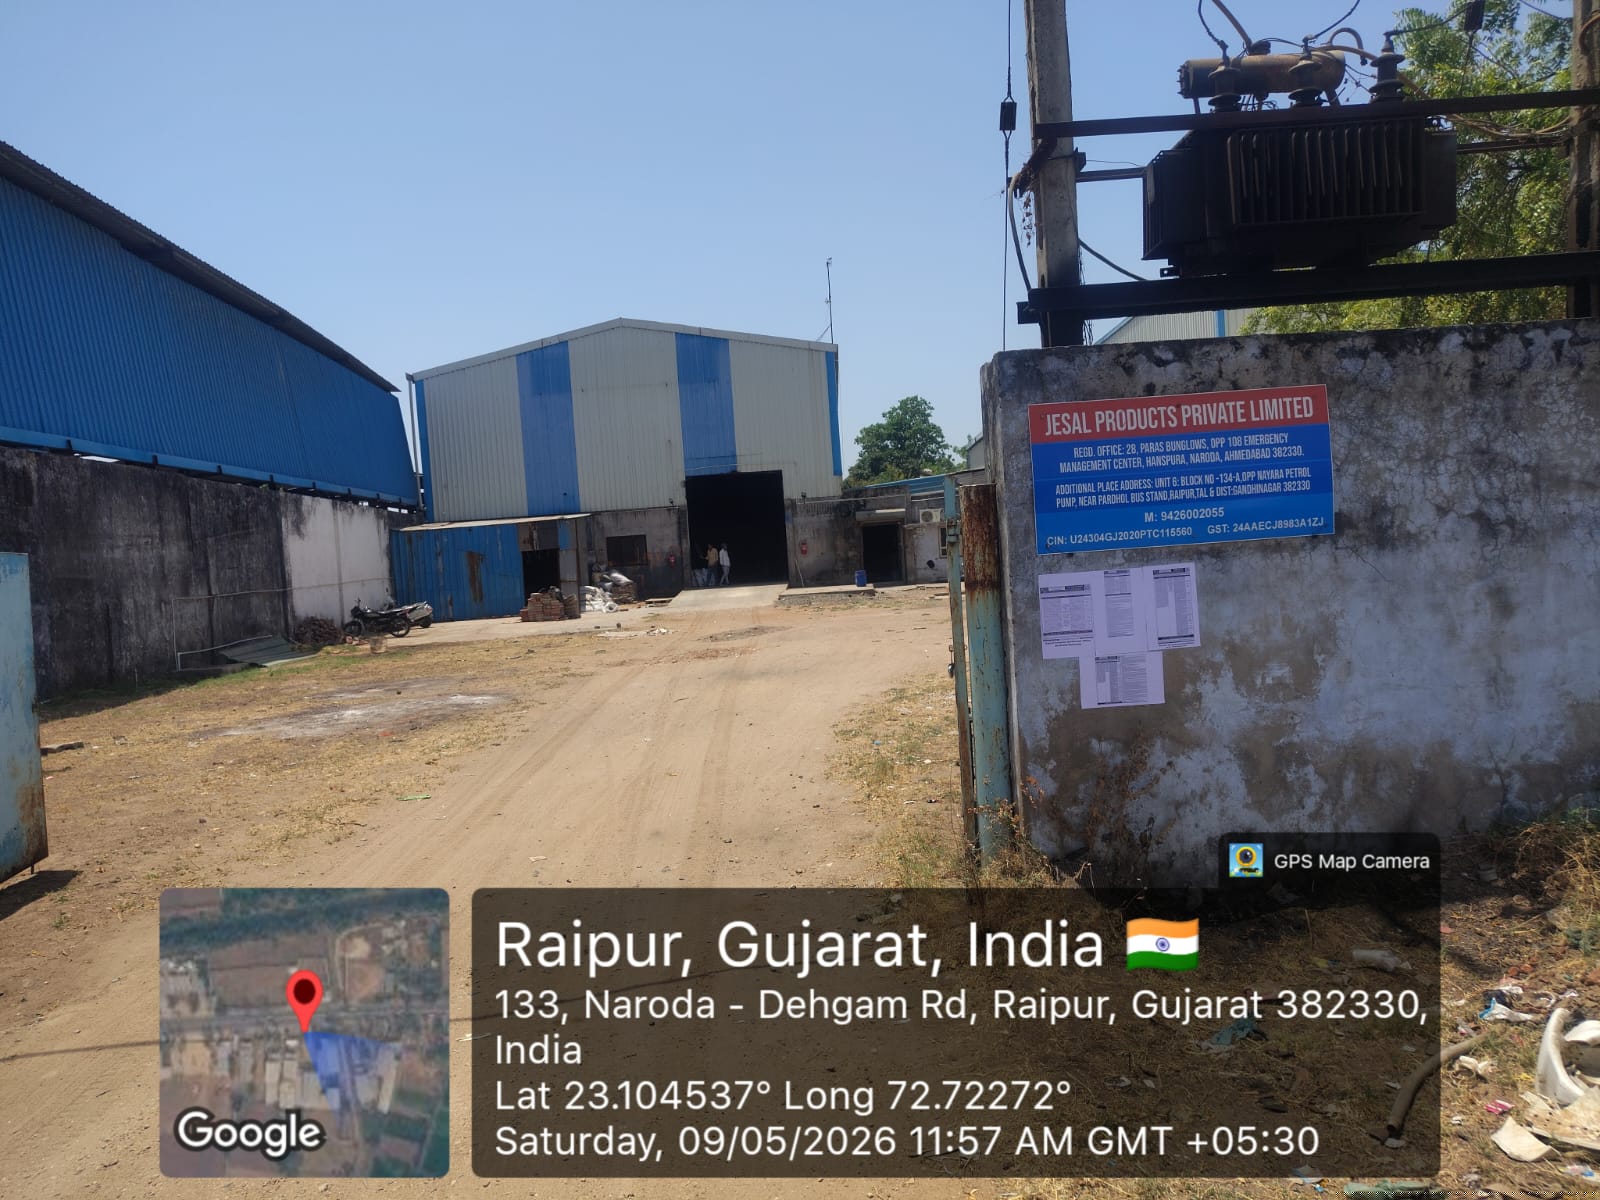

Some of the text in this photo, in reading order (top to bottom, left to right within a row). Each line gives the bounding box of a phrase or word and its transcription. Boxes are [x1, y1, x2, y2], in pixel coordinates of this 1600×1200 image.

[1045, 396, 1313, 436] JESAL PRODUCTS PRIVATE LIMITED
[1073, 446, 1095, 458] REGD.
[1097, 444, 1125, 457] OFFICE:
[1140, 441, 1164, 454] PARAS
[1165, 438, 1209, 452] BUNGLOWS,
[1210, 437, 1226, 449] OPP
[1228, 435, 1242, 448] 108
[1244, 432, 1288, 446] EMERGENCY
[1060, 459, 1112, 473] MANAGEMENT
[1113, 456, 1145, 470] CENTER,
[1146, 453, 1189, 467] HANSPURA,
[1190, 451, 1223, 464] NARODA,
[1224, 448, 1270, 462] AHMEDABAD
[1055, 482, 1096, 496] ADDITIONAL
[1097, 480, 1119, 492] PLACE
[1120, 478, 1154, 491] ADDRESS:
[1155, 476, 1172, 489] UNIT
[1180, 474, 1204, 487] BLOCK
[1204, 473, 1215, 485] NO
[1257, 468, 1285, 481] NAYARA
[1286, 466, 1312, 479] PETROL
[1079, 495, 1097, 507] NEAR
[1131, 491, 1145, 503] BUS
[1209, 486, 1215, 498] &
[1283, 479, 1311, 492] 382330
[1144, 506, 1225, 523] M: 9426002055
[1047, 536, 1067, 546] CIN:
[1207, 523, 1230, 535] GST:
